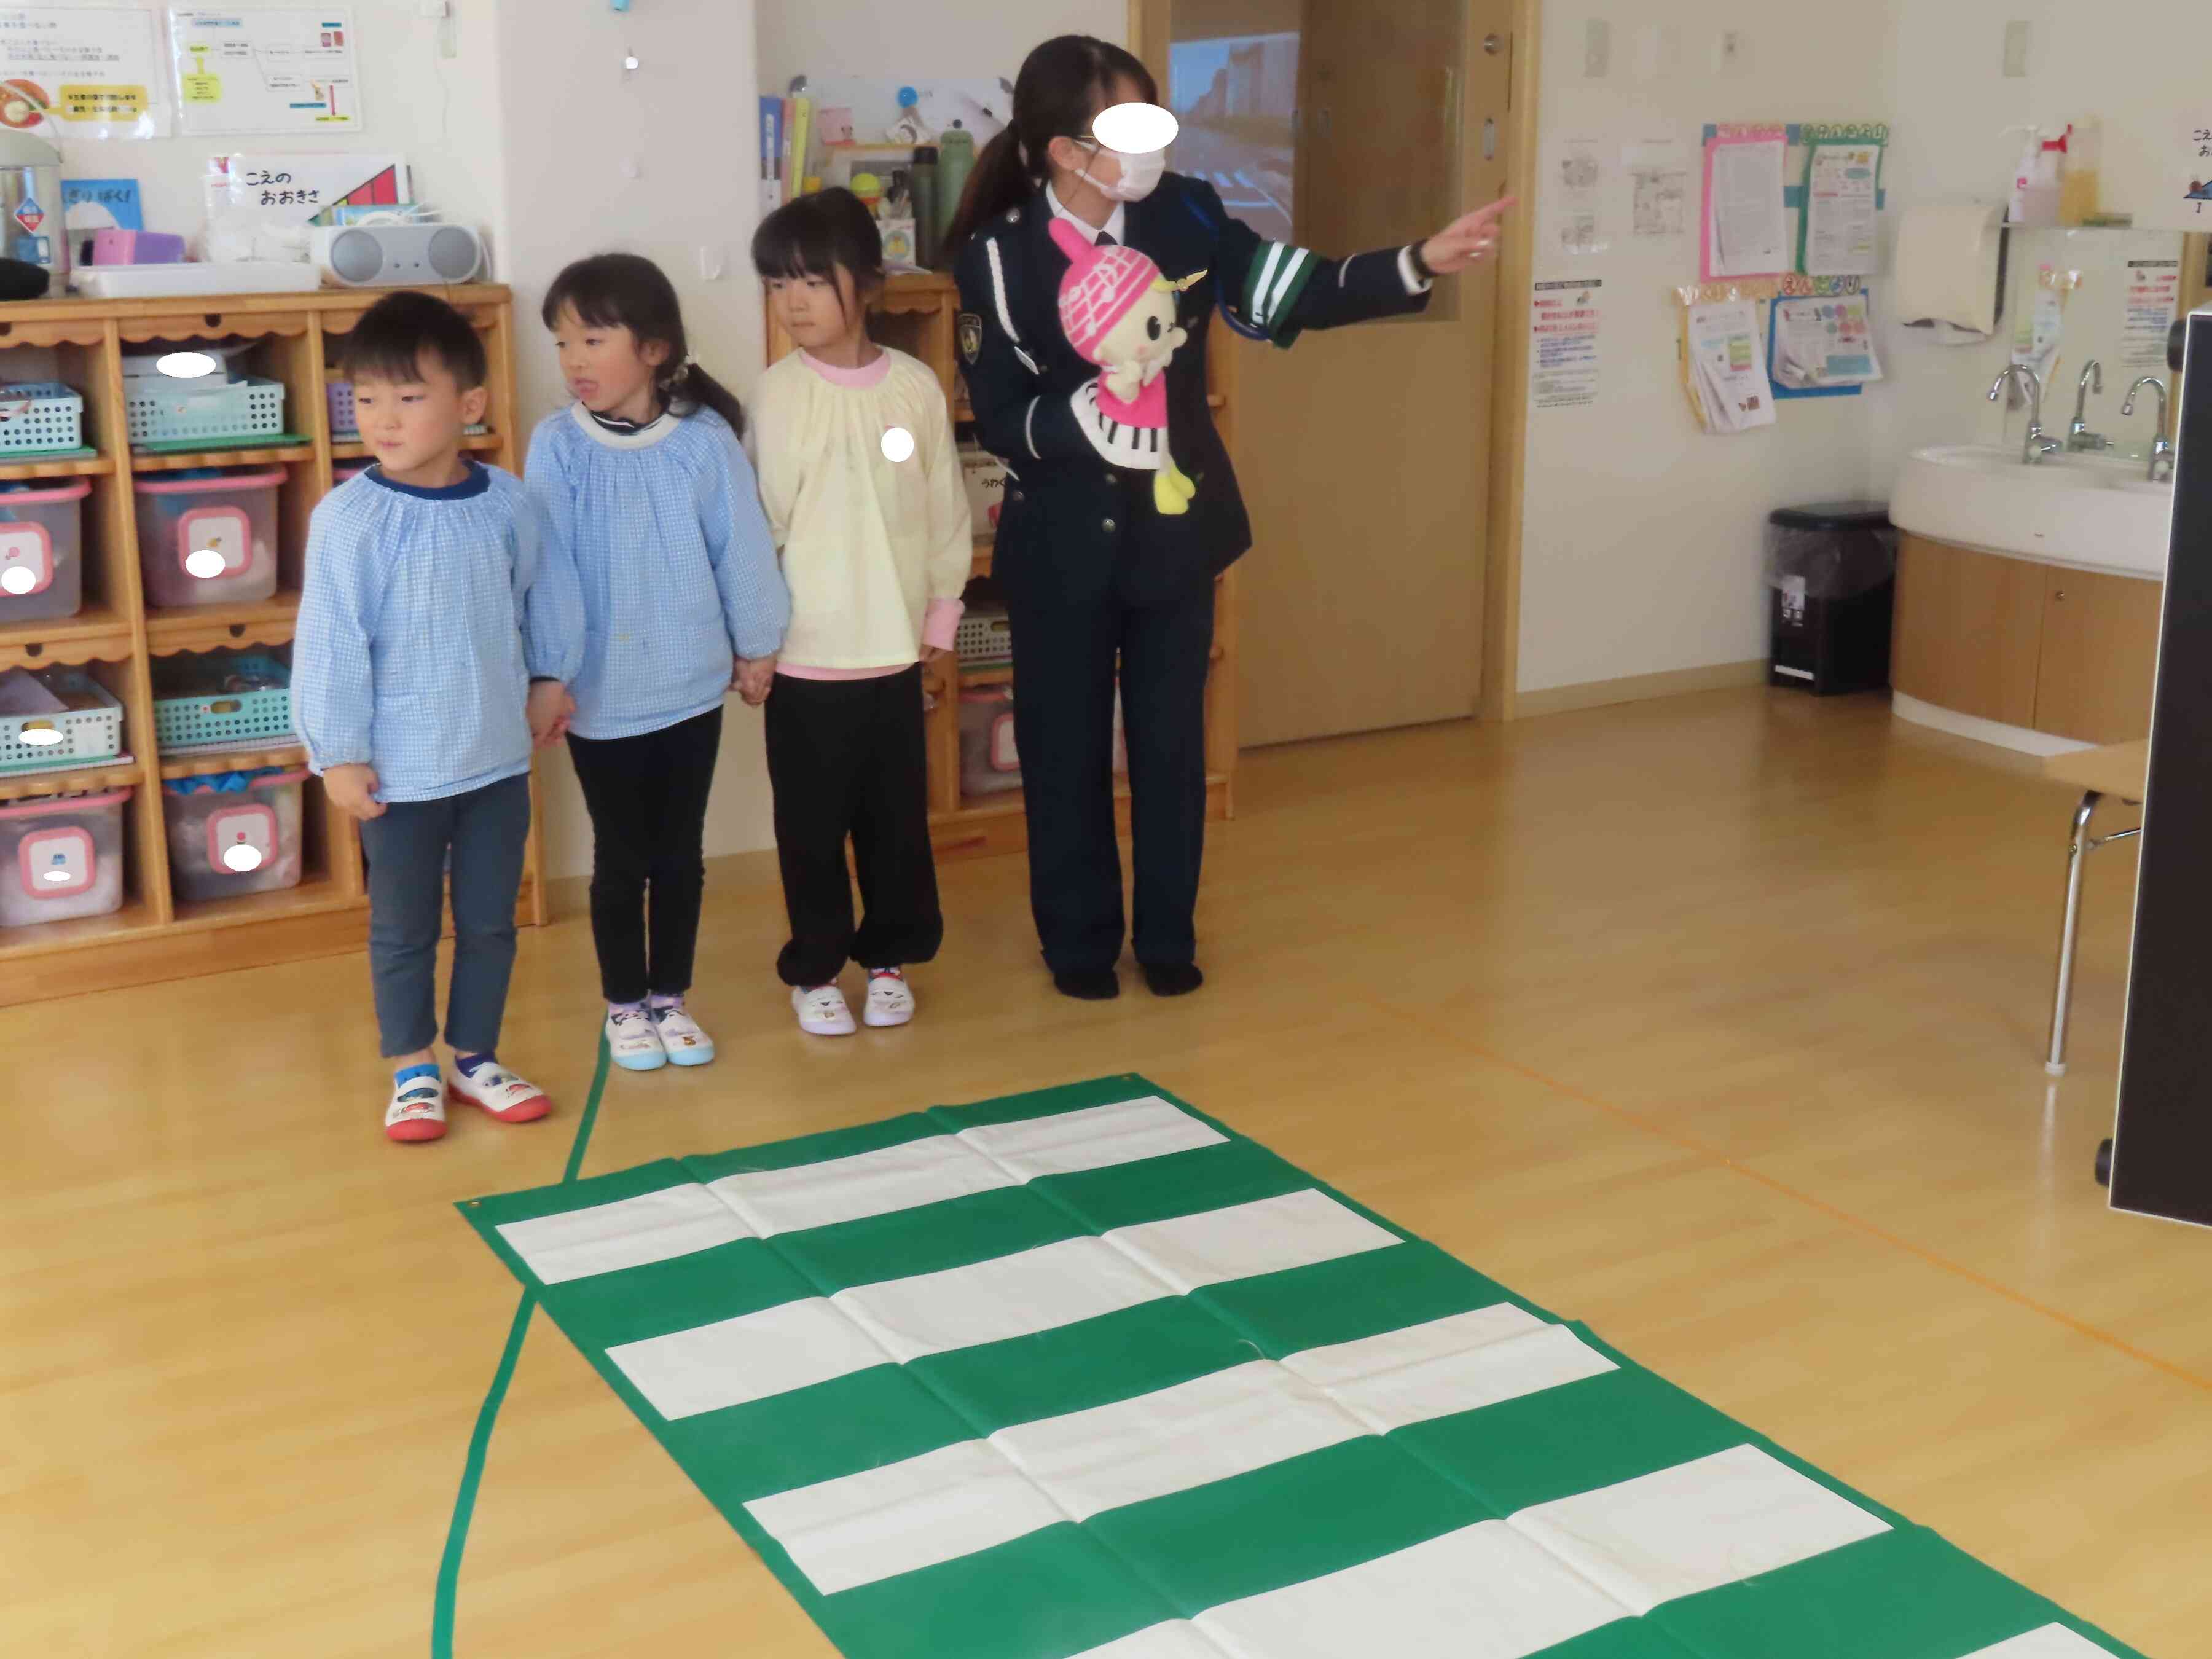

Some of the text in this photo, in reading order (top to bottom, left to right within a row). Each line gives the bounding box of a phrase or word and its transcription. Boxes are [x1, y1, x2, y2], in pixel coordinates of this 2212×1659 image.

[2193, 129, 2212, 141] こえ
[2198, 145, 2212, 157] お
[246, 170, 291, 186] こえの
[261, 190, 319, 205] おおきさ
